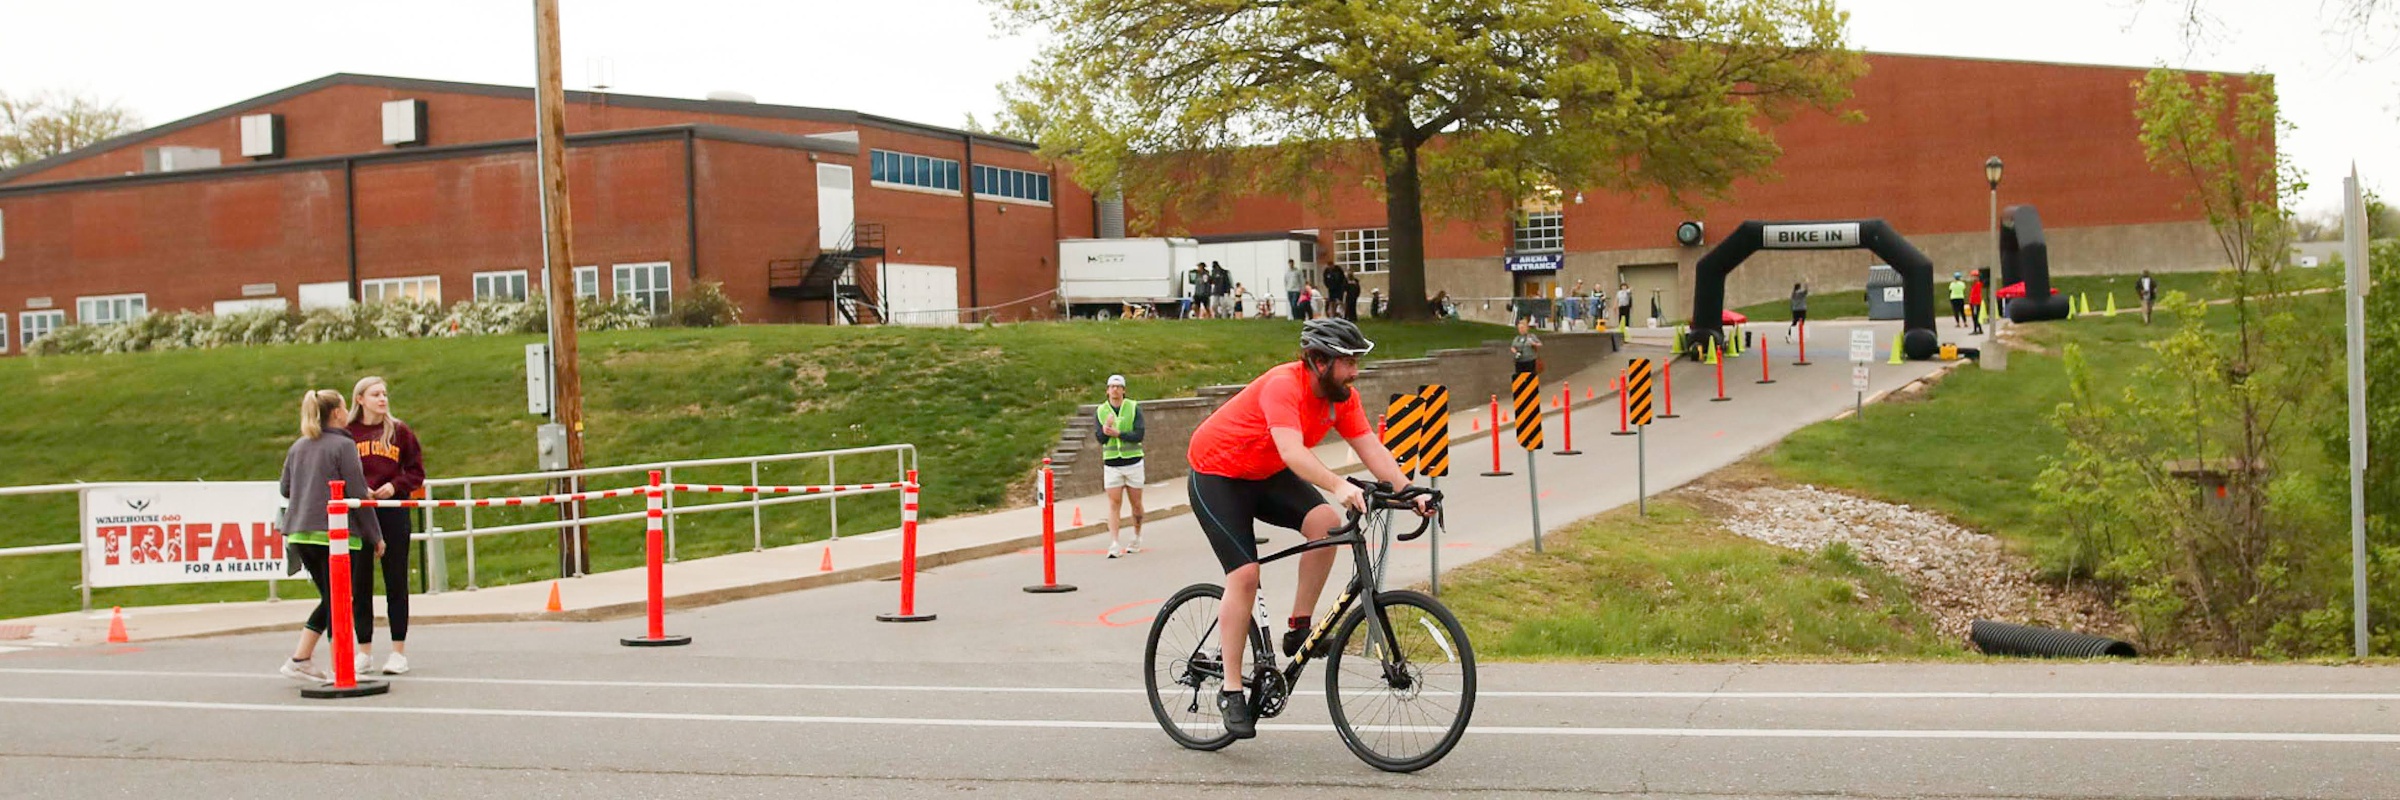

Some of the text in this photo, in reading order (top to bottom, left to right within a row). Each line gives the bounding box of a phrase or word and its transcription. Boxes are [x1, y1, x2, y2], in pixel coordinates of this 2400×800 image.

[1778, 229, 1842, 242] BIKE IN
[1510, 262, 1557, 270] ENTRANCE
[95, 514, 159, 525] WAREHOUSE
[185, 561, 282, 574] FOR A HEALTHY
